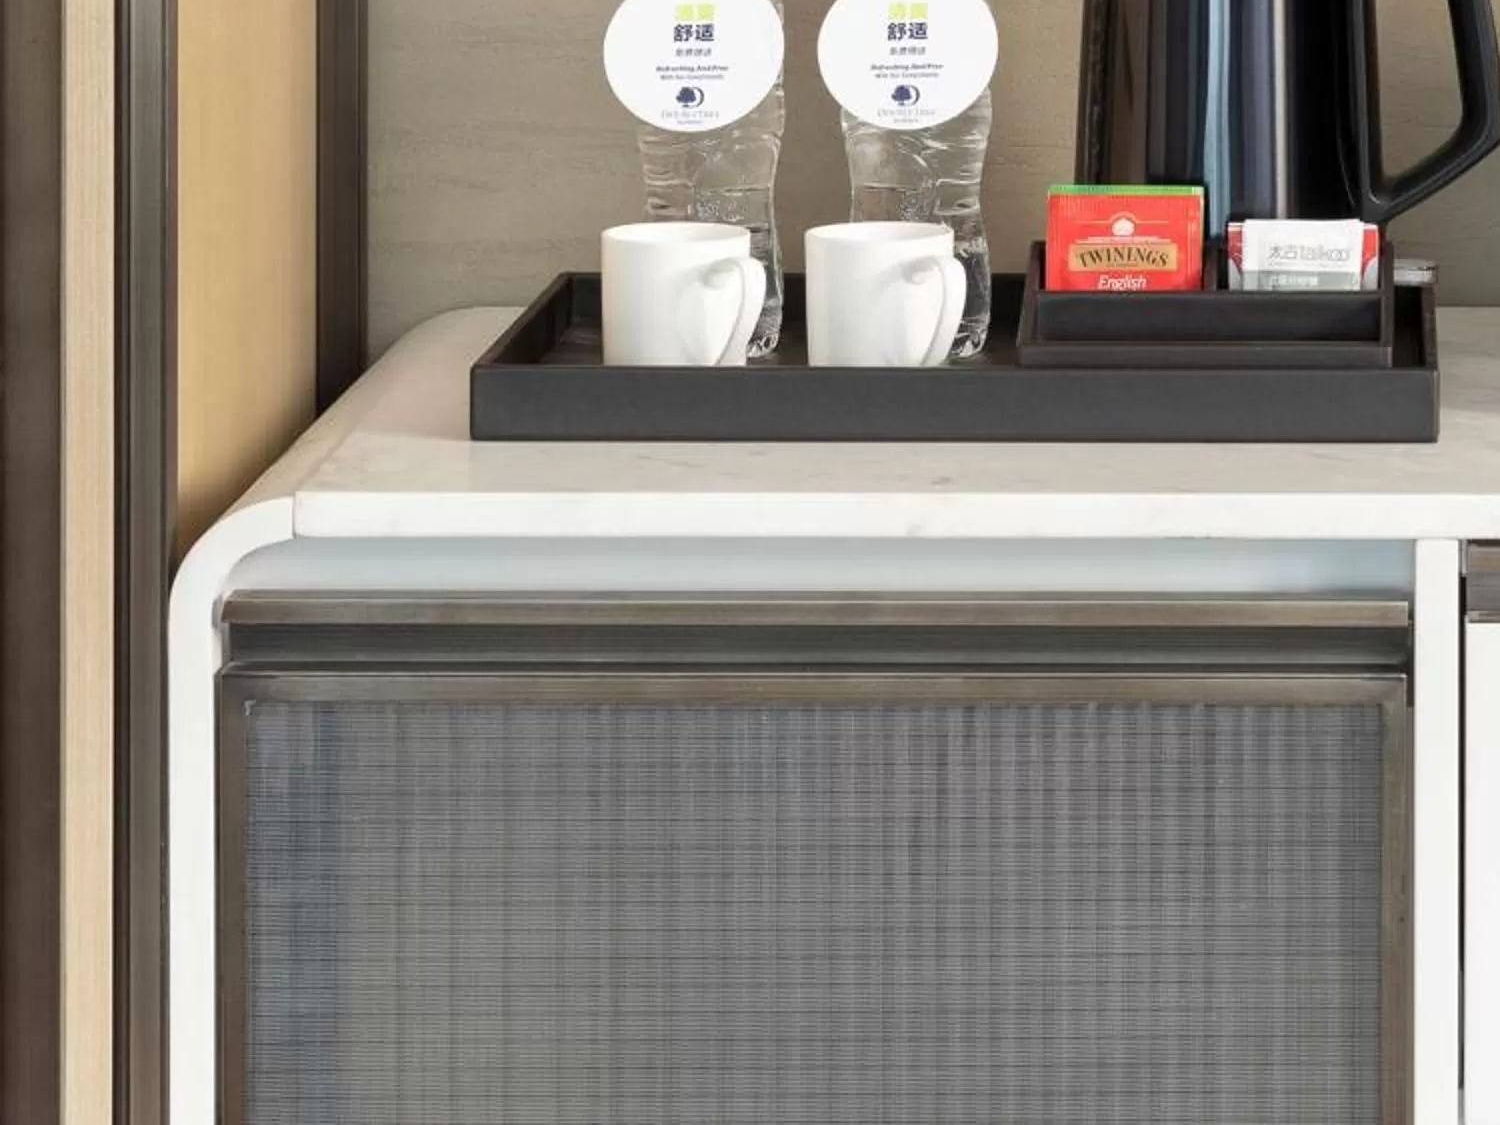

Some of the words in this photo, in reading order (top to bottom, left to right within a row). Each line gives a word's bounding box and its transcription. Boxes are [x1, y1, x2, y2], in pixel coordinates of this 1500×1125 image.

[673, 23, 715, 42] 舒适
[887, 22, 929, 42] 舒适
[1075, 245, 1169, 268] TWININGS
[1098, 274, 1148, 291] English
